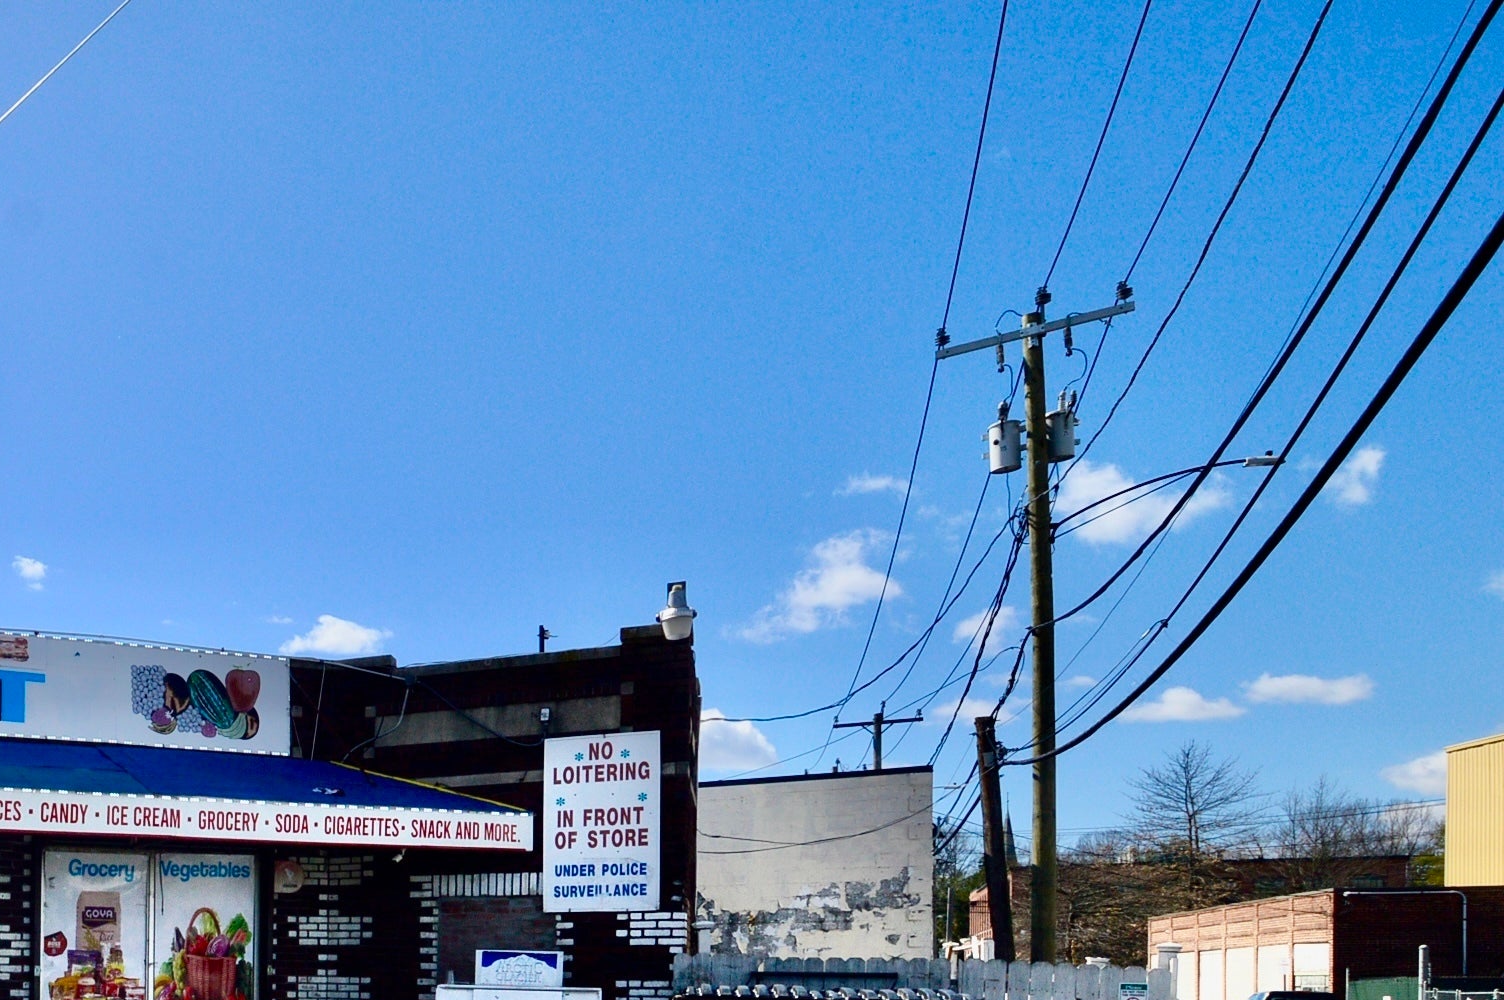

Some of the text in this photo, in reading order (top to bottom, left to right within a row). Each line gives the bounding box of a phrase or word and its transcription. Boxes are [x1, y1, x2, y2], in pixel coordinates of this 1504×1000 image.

[588, 741, 614, 761] NO
[553, 761, 651, 785] LOITERING
[40, 802, 88, 825] CANDY
[106, 805, 128, 826] ICE
[133, 806, 181, 829] CREAM
[198, 810, 259, 832] GROCERY
[275, 813, 309, 834] SODA
[324, 815, 400, 837] CIGARETTES
[411, 819, 451, 840] SNACK
[456, 821, 479, 841] AND
[484, 822, 521, 843] MORE.
[556, 806, 645, 828] IN FRONT
[554, 828, 649, 850] OF STORE
[68, 859, 135, 882] Grocery
[161, 860, 250, 882] Vegetables
[554, 862, 647, 877] UNDER POLICE
[85, 909, 113, 918] GOYA
[496, 961, 543, 974] ARCTIC
